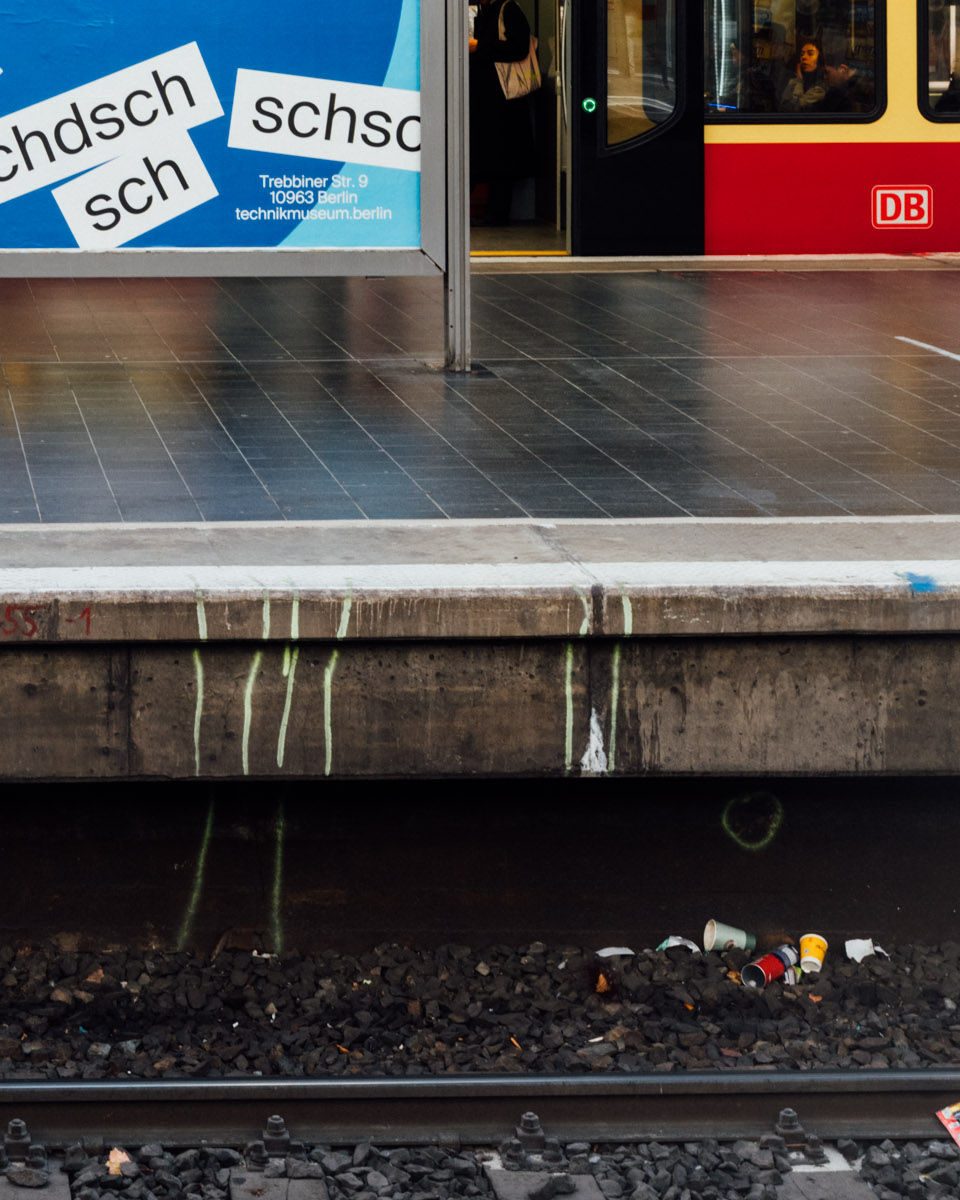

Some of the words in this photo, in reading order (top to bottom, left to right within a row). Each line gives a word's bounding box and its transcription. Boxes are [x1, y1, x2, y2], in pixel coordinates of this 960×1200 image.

[252, 92, 421, 153] schsc
[258, 174, 329, 189] Trebbiner
[331, 174, 355, 189] Str.
[358, 174, 369, 189] 9
[85, 156, 190, 231] sch
[269, 190, 314, 205] 10963
[317, 190, 359, 205] Berlin
[234, 206, 393, 221] technikmuseum.berlin
[879, 192, 926, 222] DB
